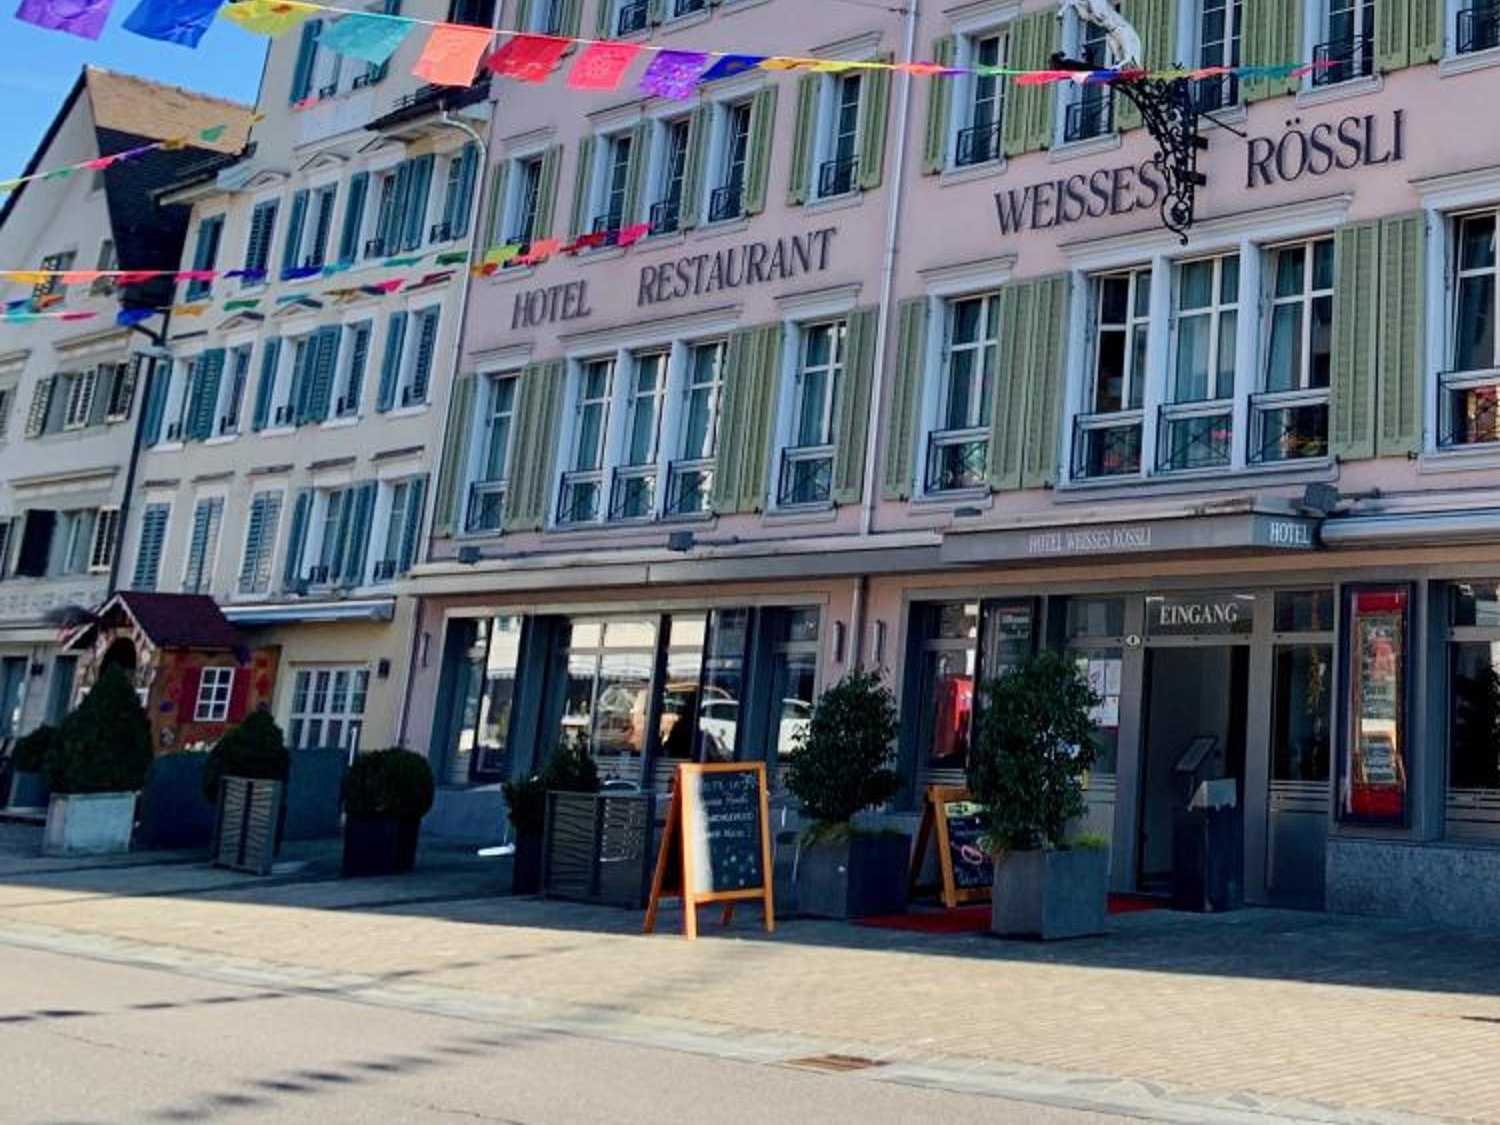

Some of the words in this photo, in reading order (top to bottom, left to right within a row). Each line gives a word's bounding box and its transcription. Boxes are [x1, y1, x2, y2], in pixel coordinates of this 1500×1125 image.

[994, 159, 1164, 236] WEISSES
[1244, 108, 1408, 190] RÖSSLI
[510, 279, 592, 330] HOTEL
[637, 226, 838, 307] RESTAURANT
[1028, 531, 1062, 553] HOTEL
[1269, 522, 1311, 545] HOTEL
[1160, 601, 1238, 625] EINGANG
